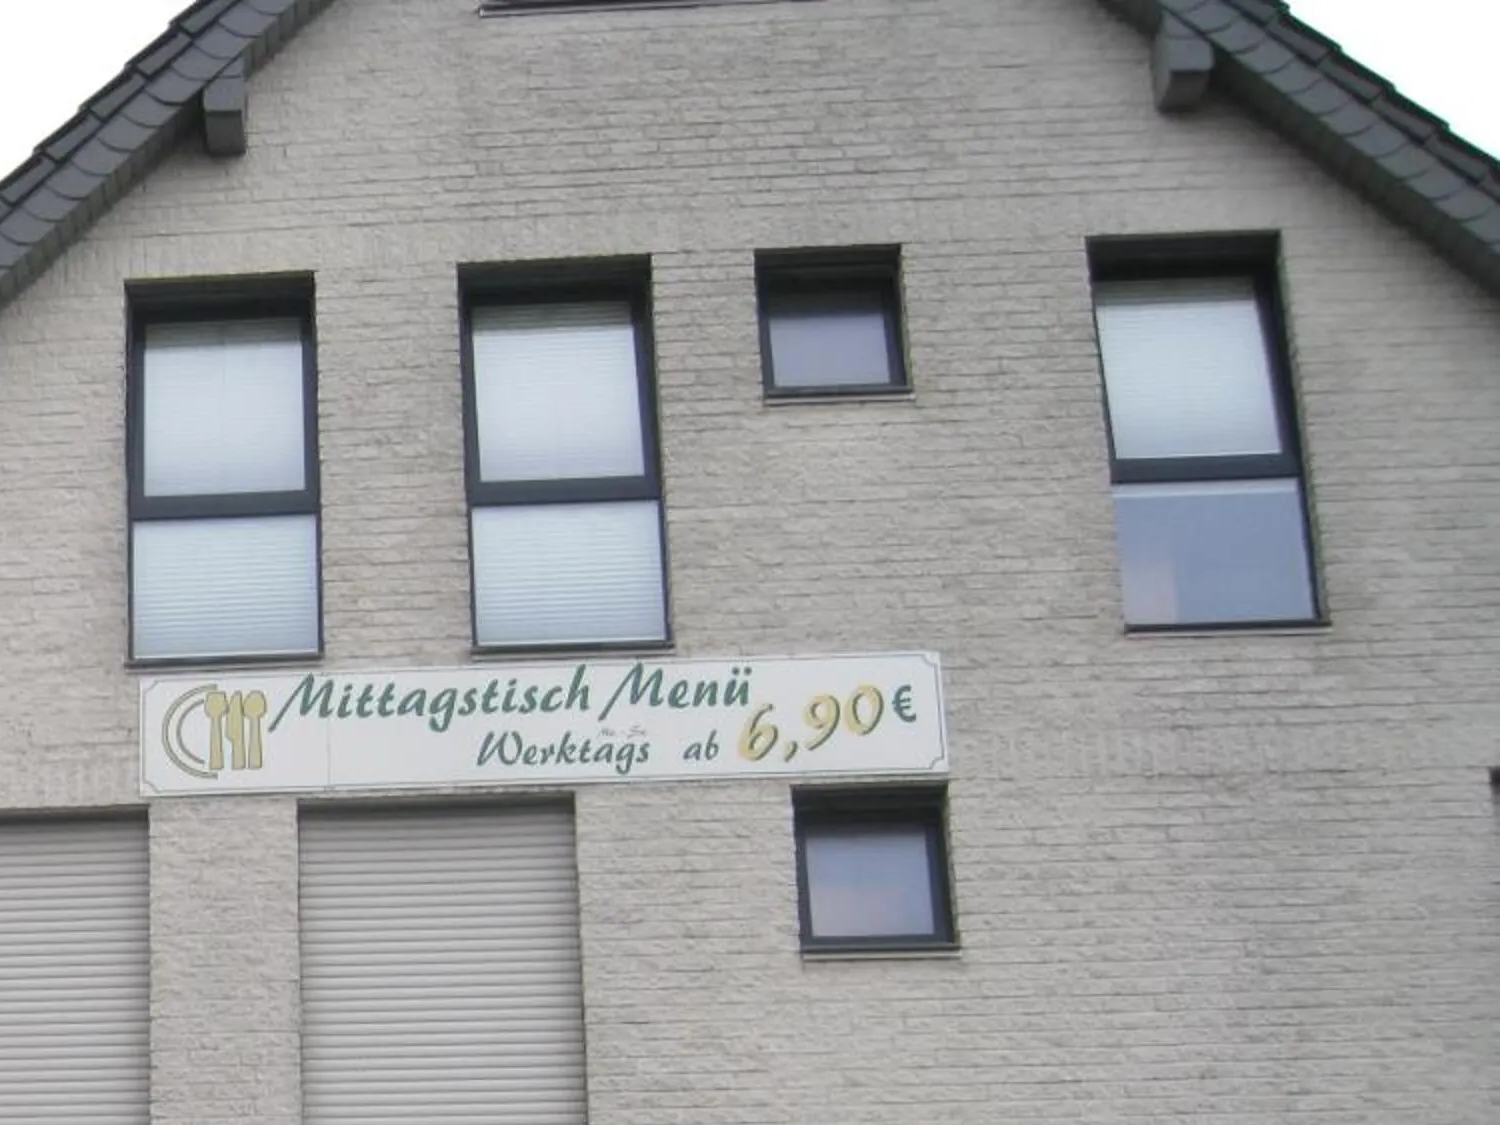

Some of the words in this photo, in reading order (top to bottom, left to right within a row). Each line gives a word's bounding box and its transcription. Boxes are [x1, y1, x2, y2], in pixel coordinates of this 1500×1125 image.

[267, 663, 591, 733] Mittagstisch
[597, 660, 753, 722] Menü
[476, 730, 650, 775] Werktags
[682, 728, 720, 762] ab
